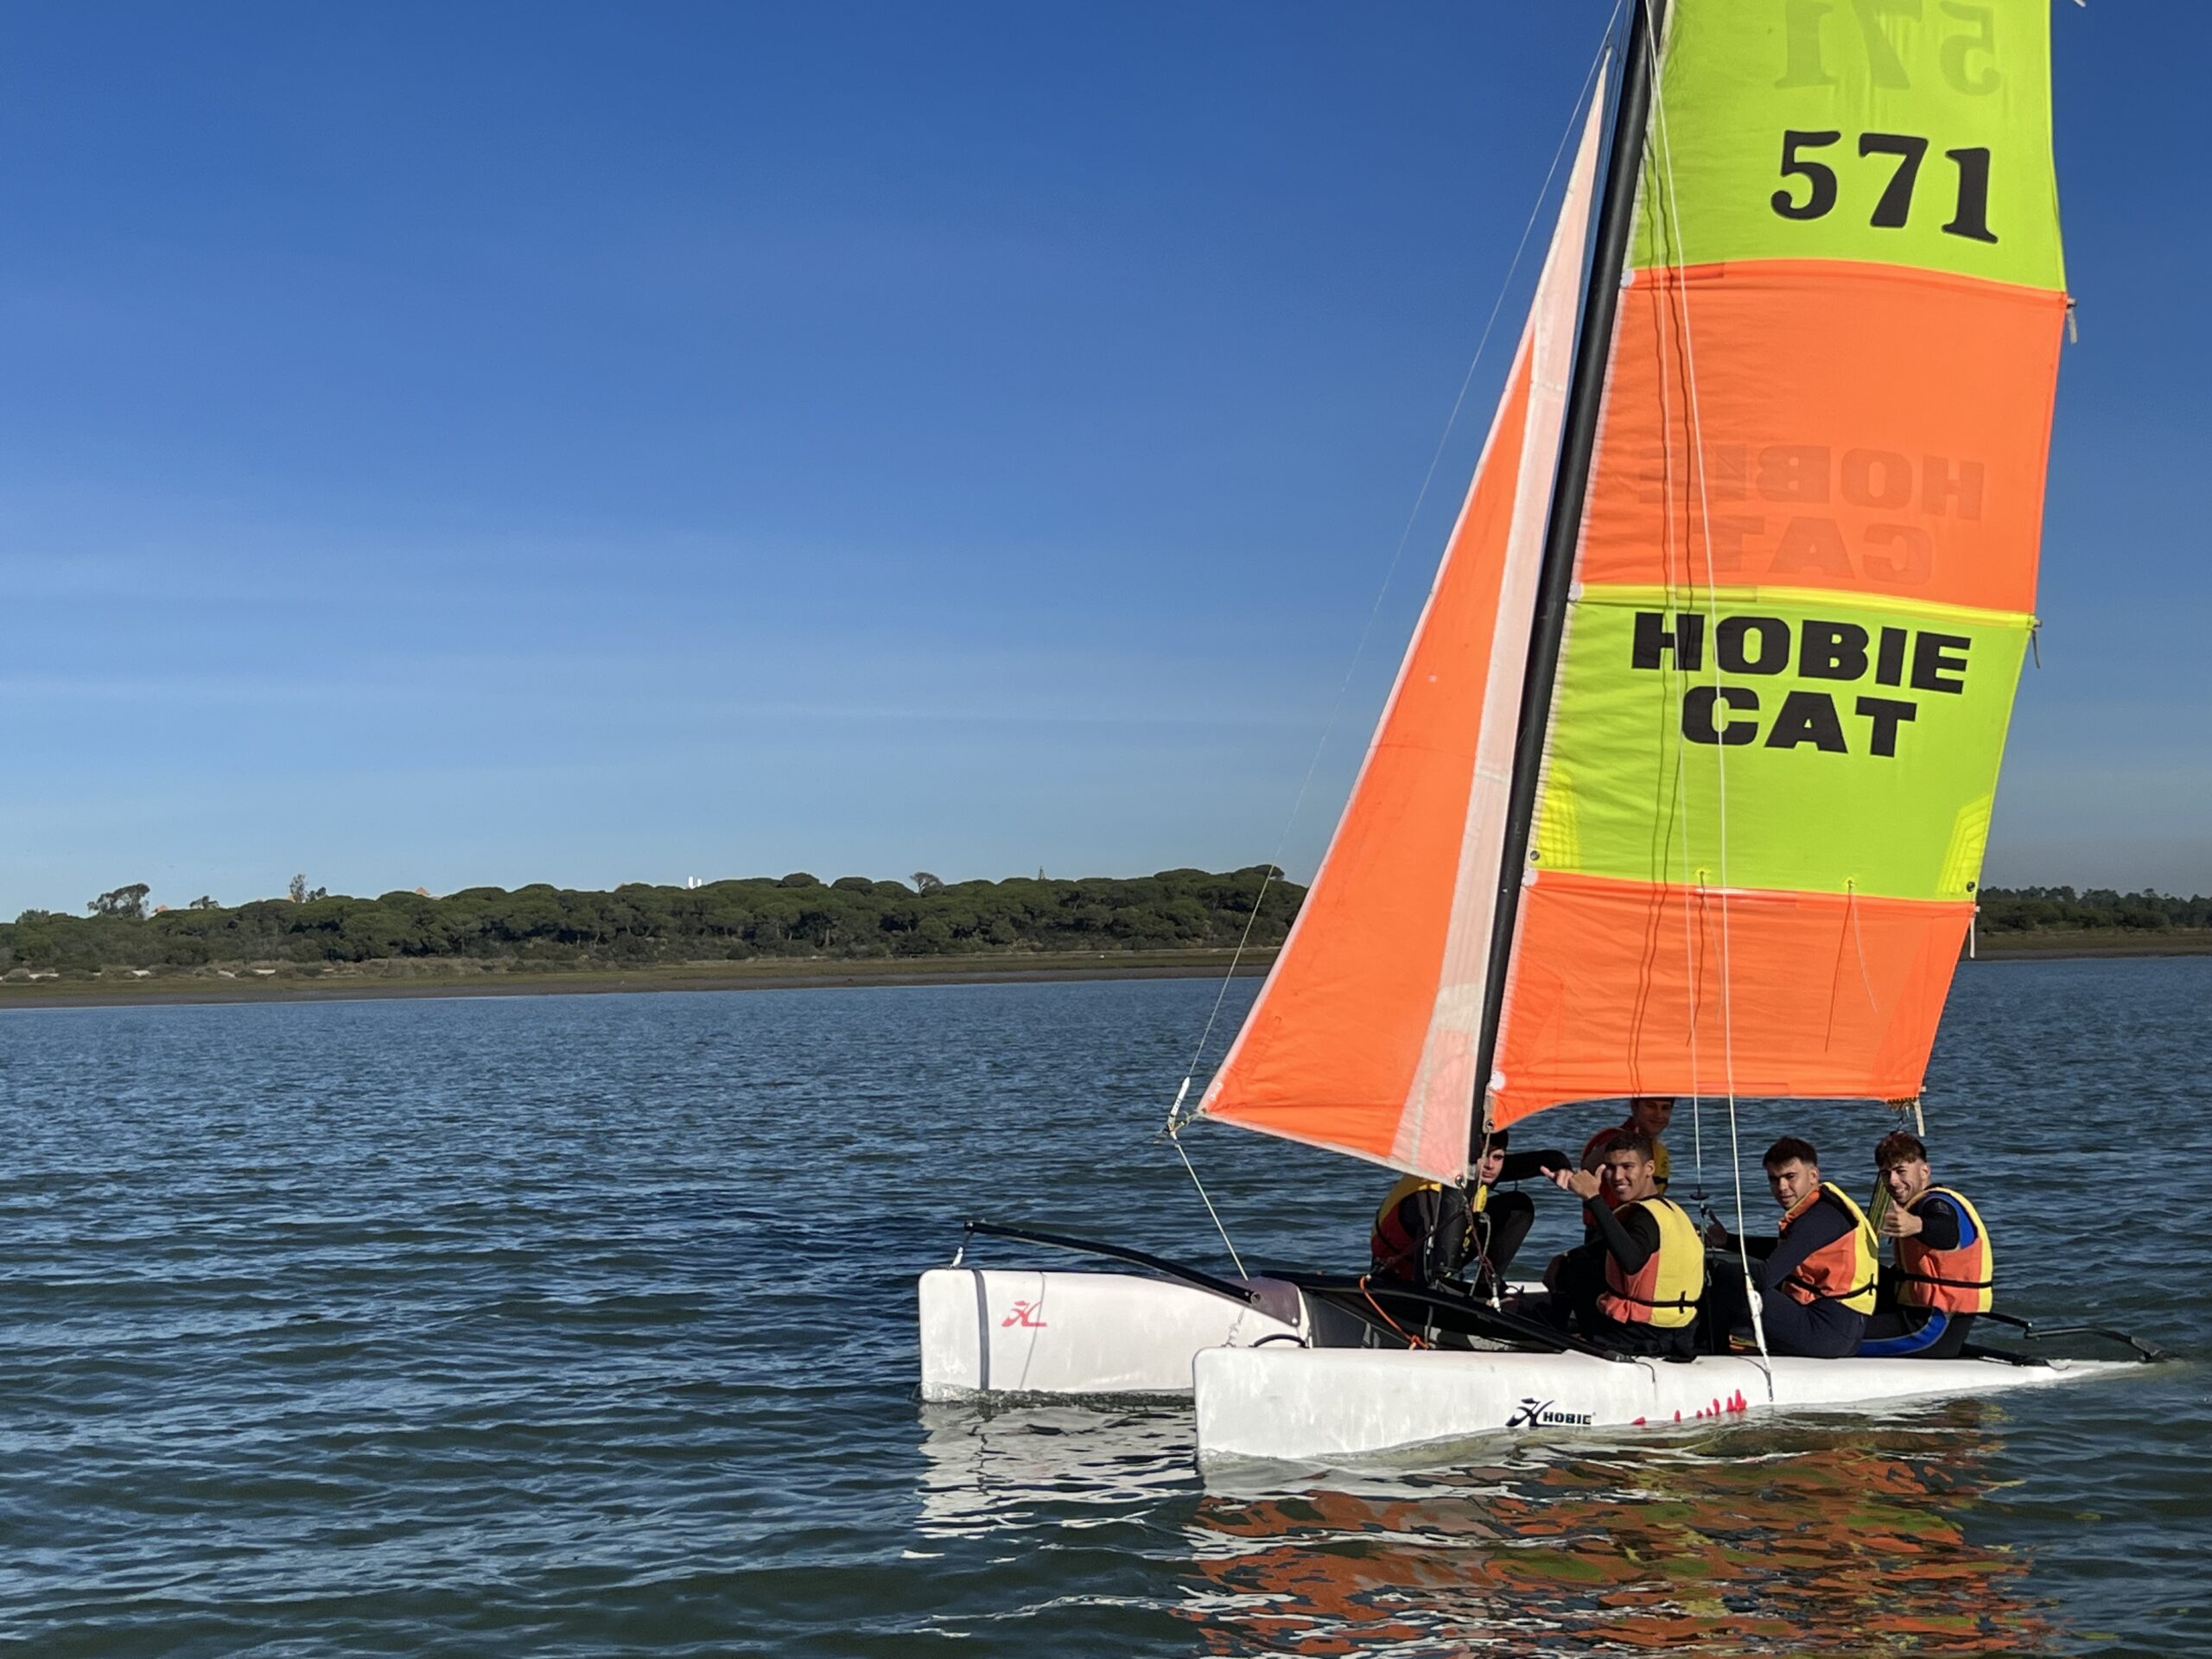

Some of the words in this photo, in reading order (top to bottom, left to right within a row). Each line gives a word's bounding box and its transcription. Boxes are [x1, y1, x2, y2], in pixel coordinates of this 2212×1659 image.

[1770, 130, 1998, 245] 571
[1631, 612, 1972, 695] HOBIE
[1681, 685, 1917, 758] CAT
[1542, 1411, 1592, 1425] HOBIE
